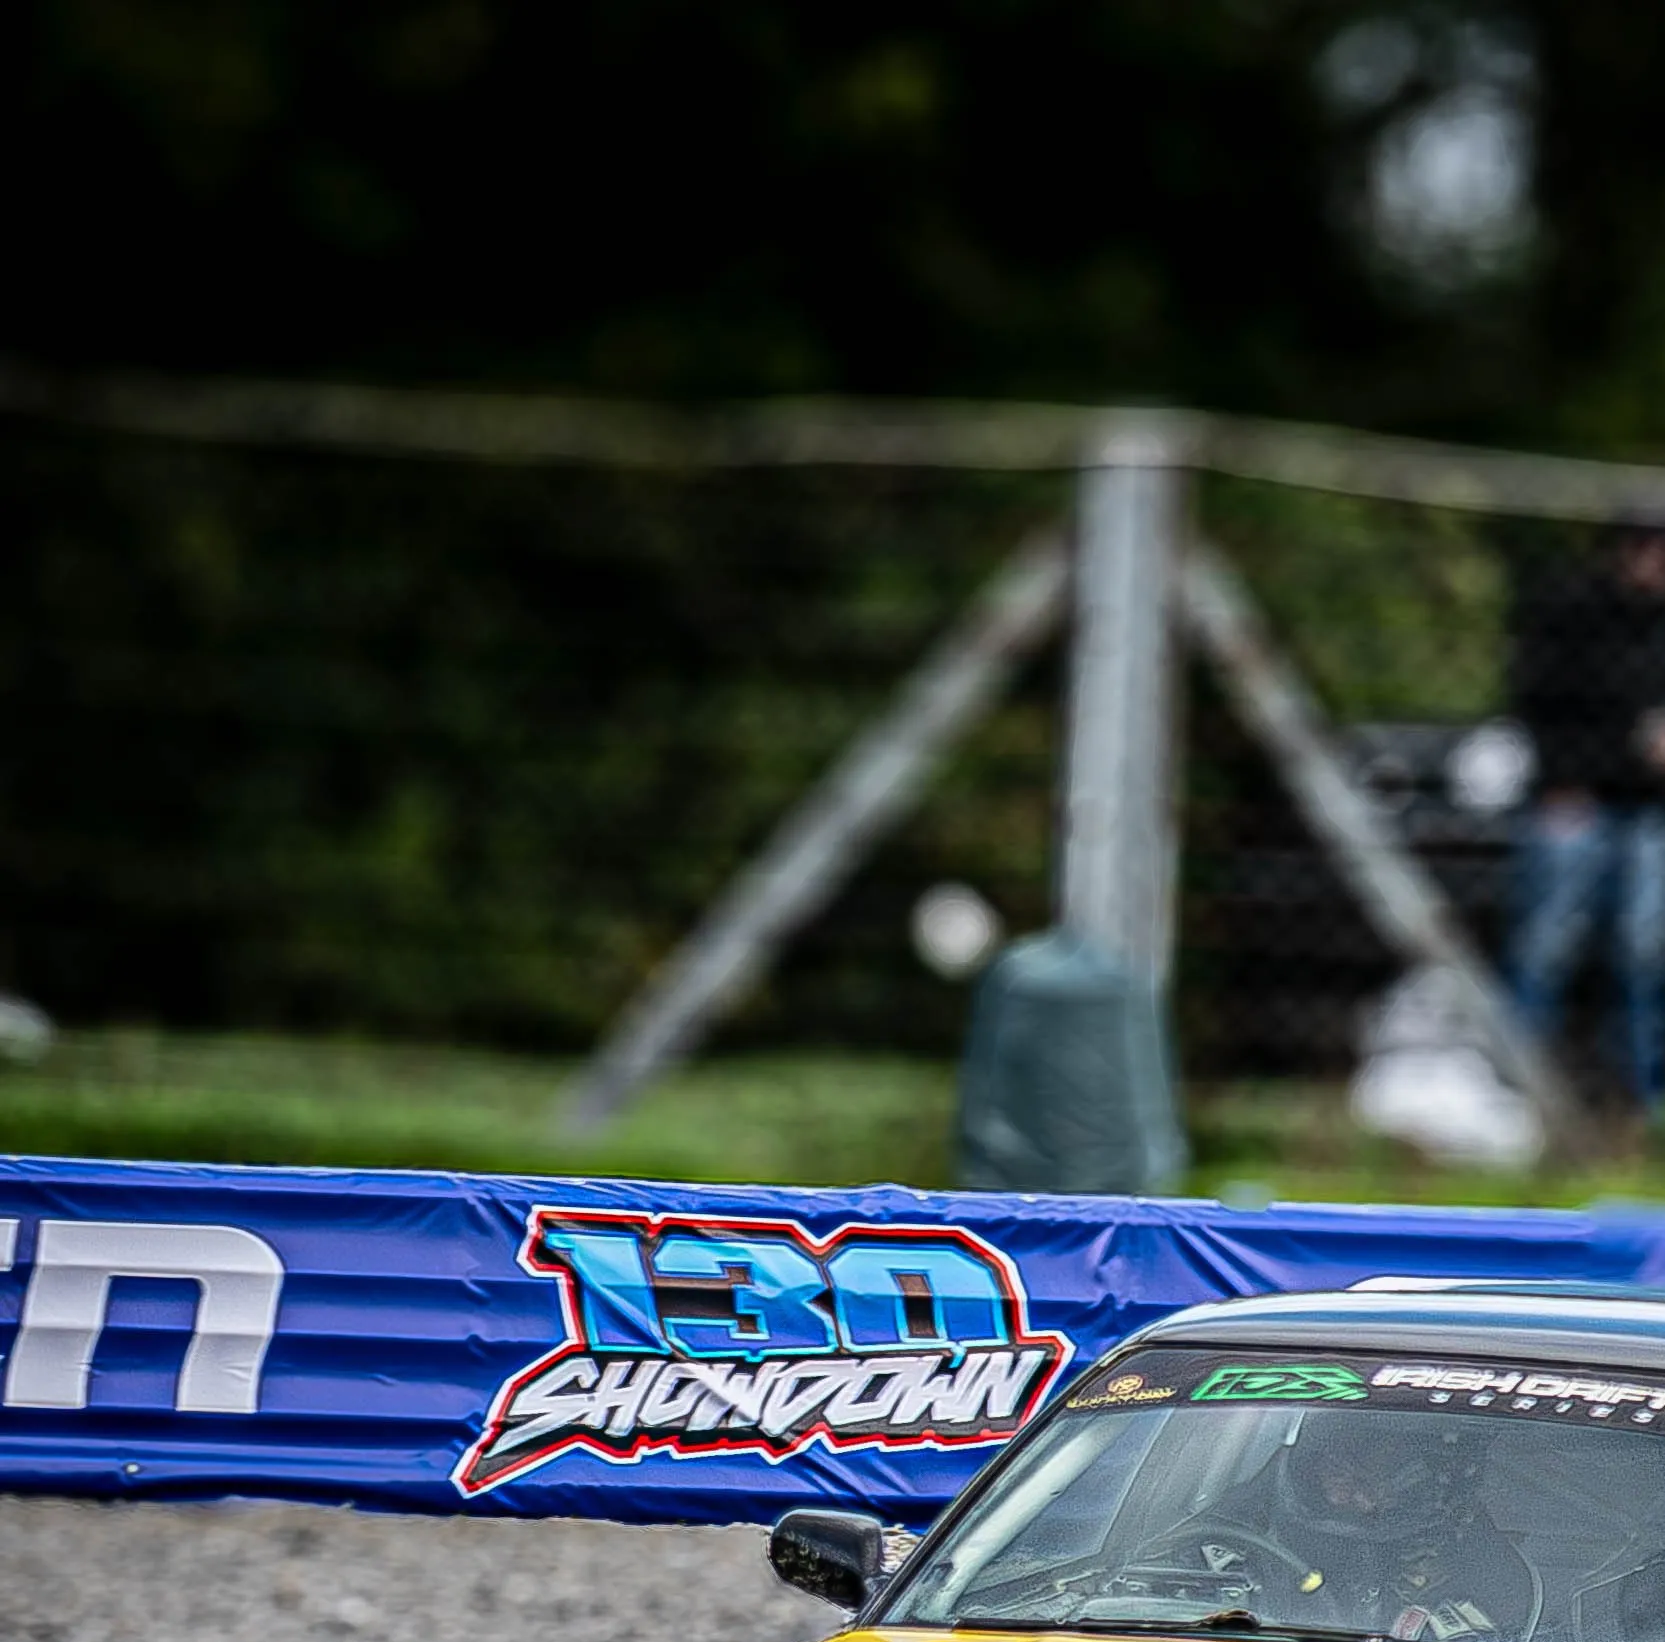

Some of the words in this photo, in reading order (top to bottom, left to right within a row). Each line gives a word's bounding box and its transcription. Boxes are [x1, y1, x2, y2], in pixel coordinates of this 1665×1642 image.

[545, 1232, 1008, 1356] 130
[487, 1347, 1046, 1456] SHOWDOWN
[1371, 1364, 1524, 1394] IRISH
[1428, 1391, 1656, 1424] SERIES
